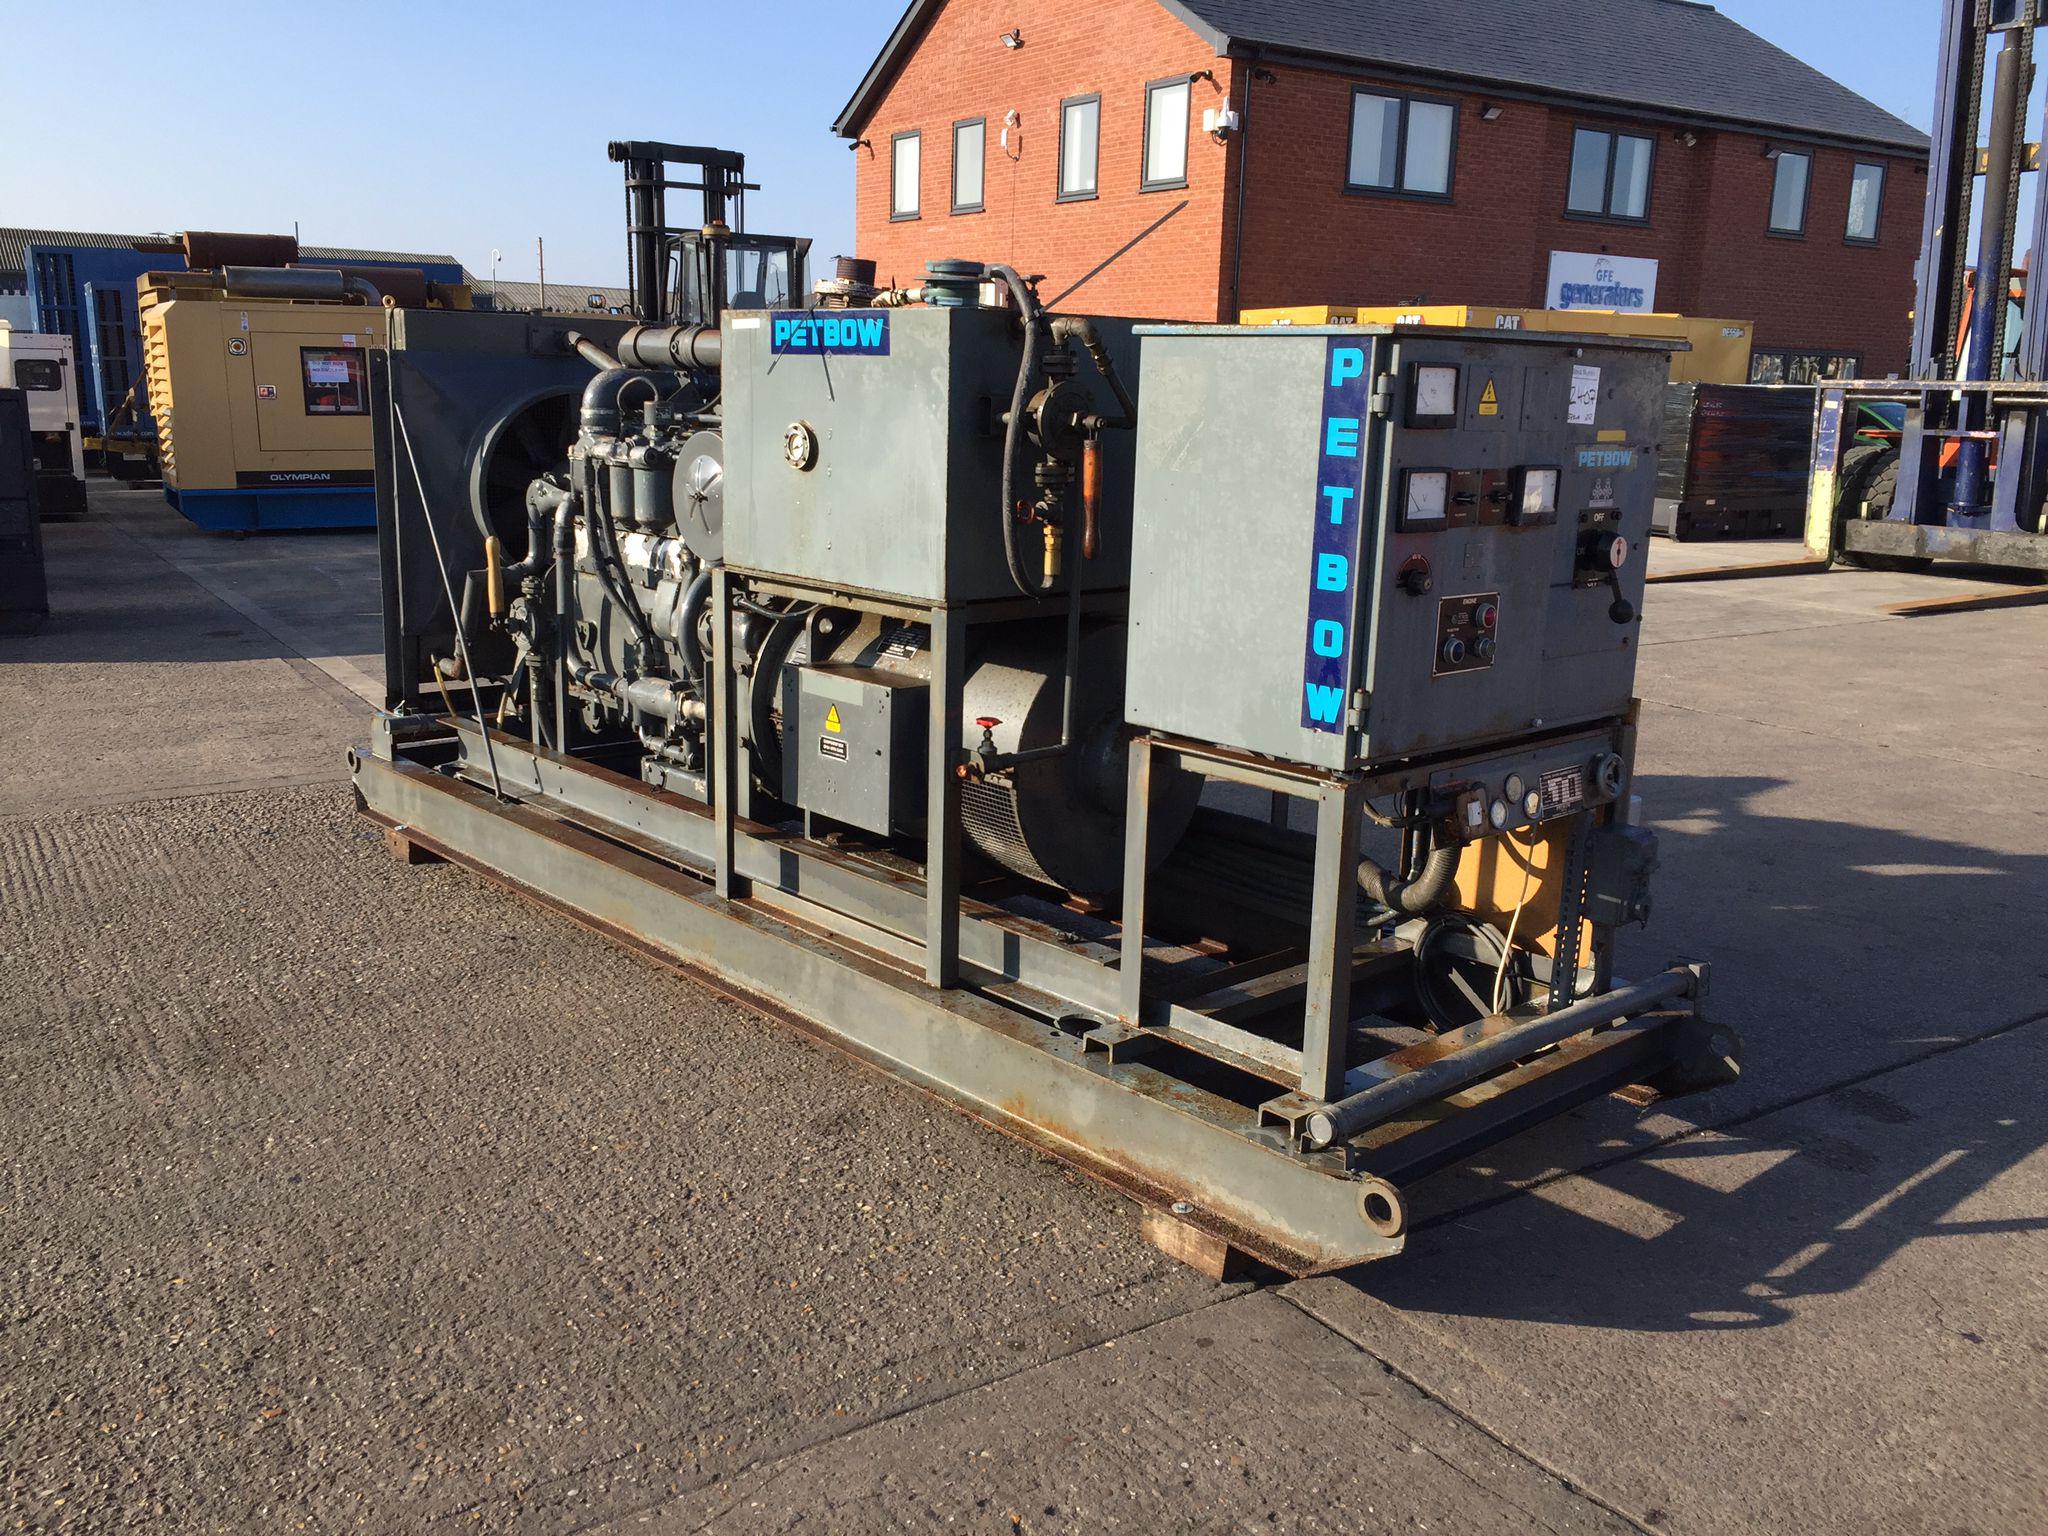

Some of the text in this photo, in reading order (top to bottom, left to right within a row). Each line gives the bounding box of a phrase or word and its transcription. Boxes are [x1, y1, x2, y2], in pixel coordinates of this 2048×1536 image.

[1596, 269, 1614, 282] GFE
[1559, 281, 1644, 309] generators
[1495, 314, 1520, 330] CAT
[775, 318, 885, 347] PETBOW
[1578, 450, 1633, 467] PETBOW
[270, 473, 331, 481] OLYMPIAN
[1593, 512, 1606, 522] OFF
[1306, 347, 1365, 724] PETBOW
